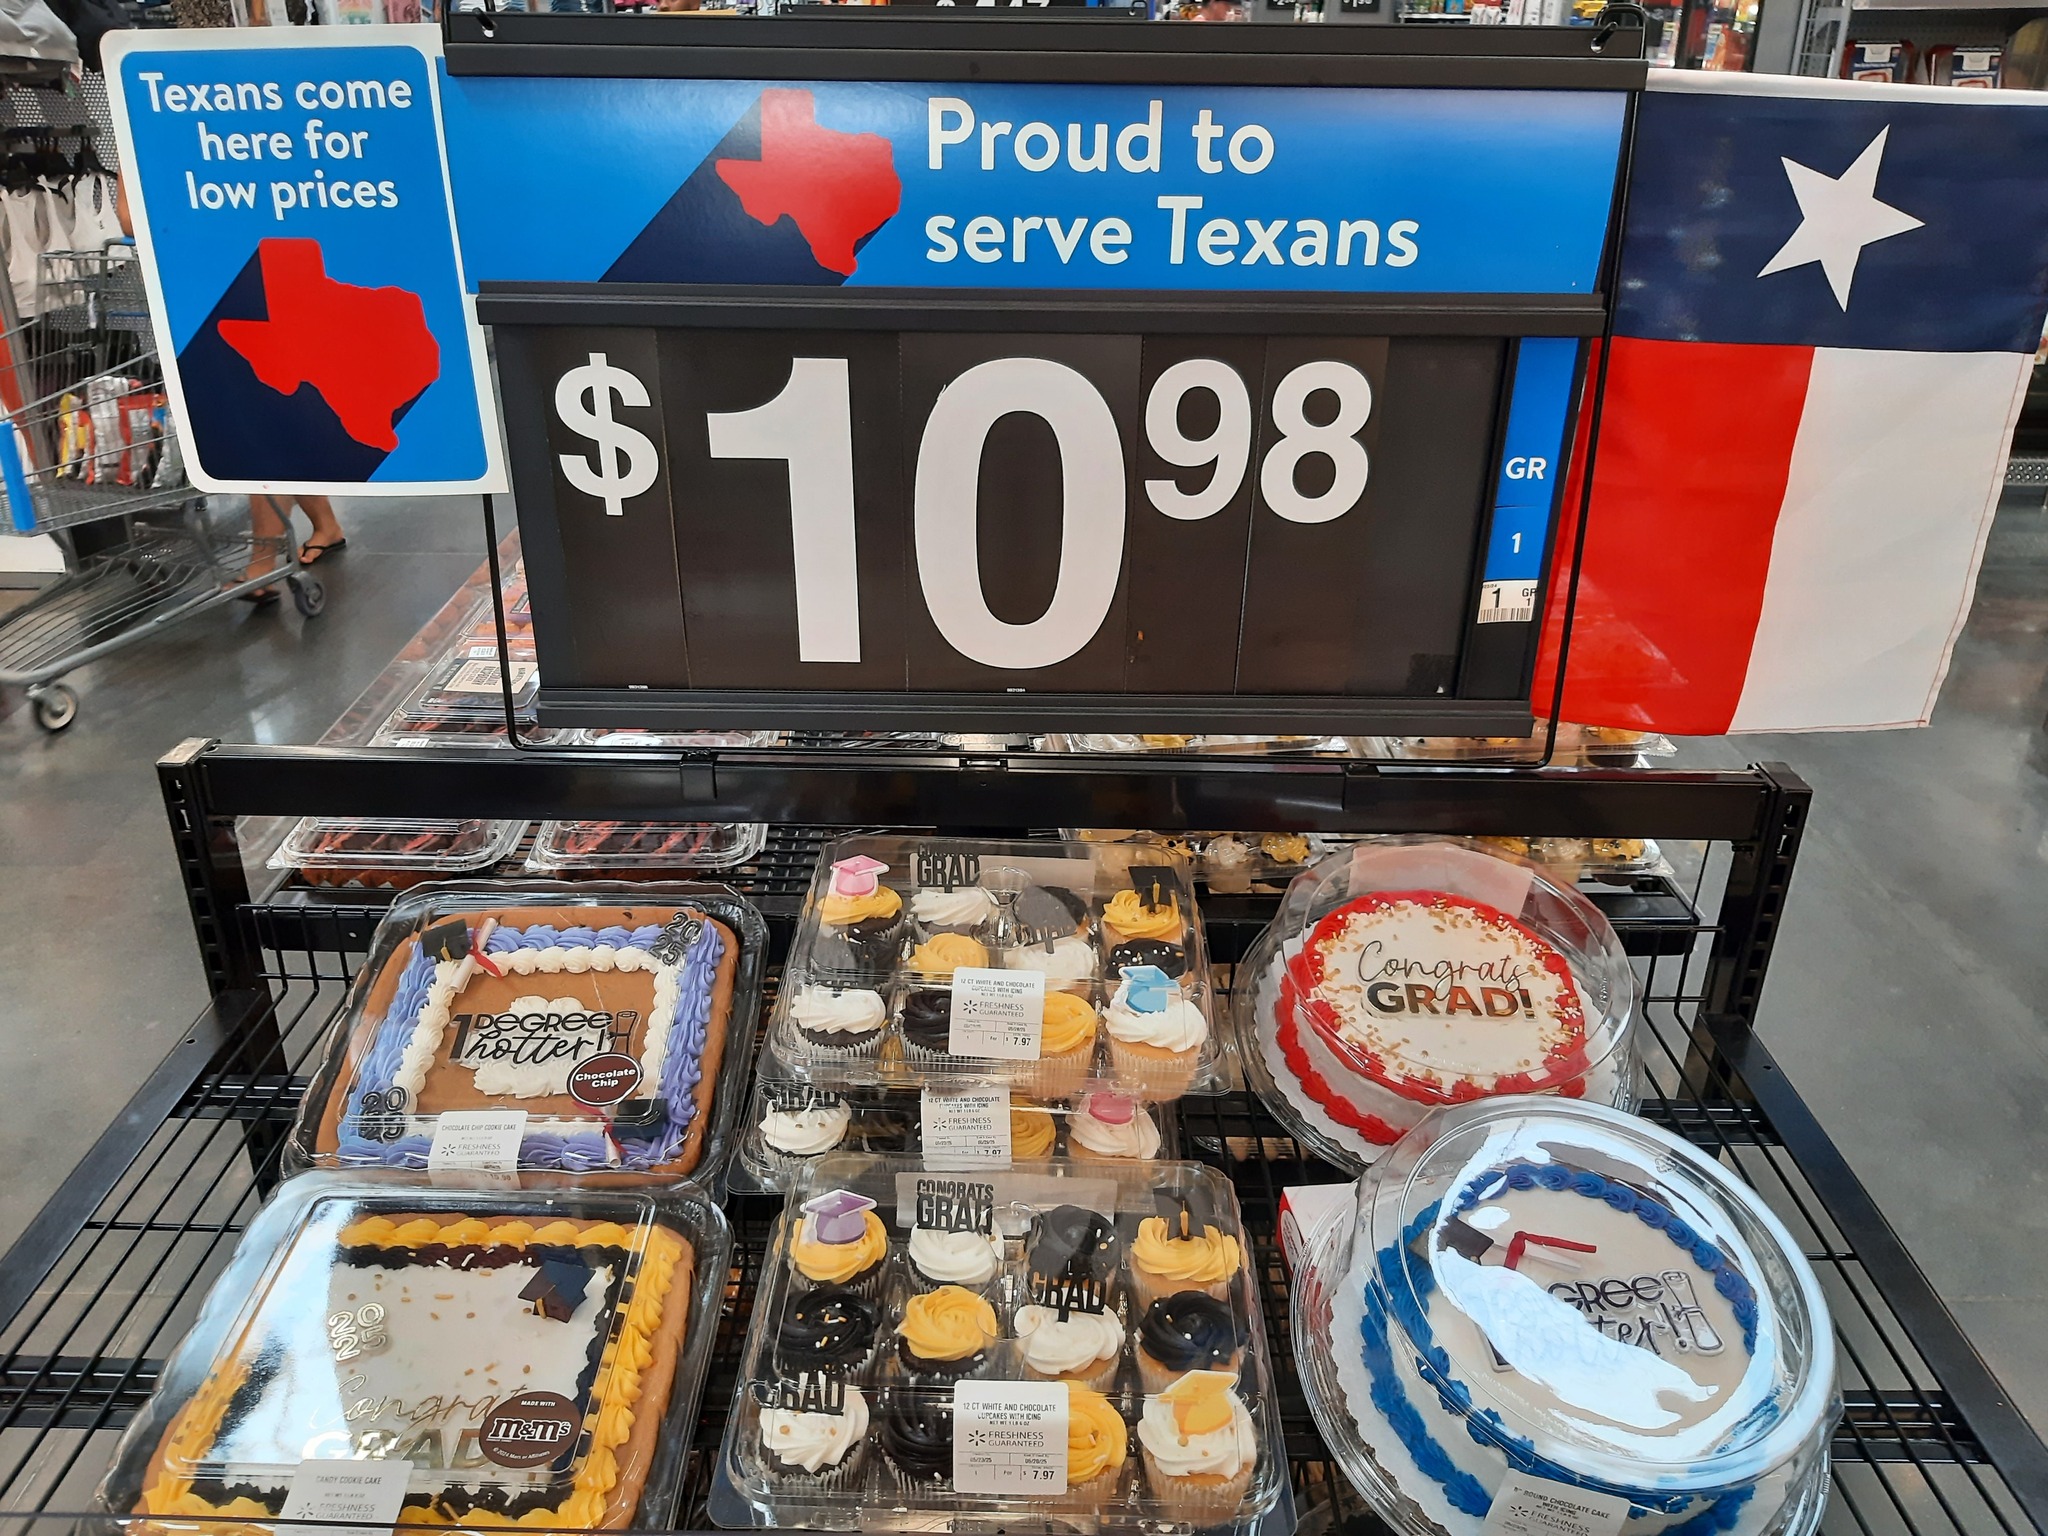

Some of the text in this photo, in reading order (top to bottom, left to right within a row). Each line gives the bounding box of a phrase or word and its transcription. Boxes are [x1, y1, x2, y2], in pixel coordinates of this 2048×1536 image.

[139, 73, 412, 112] Texans come
[197, 119, 369, 161] here for
[927, 96, 1275, 175] Proud to
[185, 169, 398, 221] low prices
[925, 195, 1420, 267] serve Texans
[1505, 457, 1547, 480] GR
[1511, 532, 1522, 554] 1
[1492, 587, 1501, 609] 1
[917, 855, 981, 888] GRAD
[1358, 940, 1530, 1001] Congrats
[1005, 981, 1035, 989] CHOCOLATE
[979, 1001, 1024, 1011] FRESHNESS
[1366, 981, 1537, 1020] GRAD!
[979, 1009, 1024, 1018] GUARANTEED
[449, 1014, 473, 1059] 1
[1013, 1036, 1031, 1046] 7.97
[575, 1068, 636, 1082] Chocolate
[591, 1078, 619, 1088] Chip
[916, 1178, 994, 1201] CONGRATS
[916, 1193, 993, 1235] GRAD
[328, 1302, 386, 1338] 20
[332, 1324, 388, 1362] 25
[963, 1402, 1056, 1412] 12 CT WHITE AND CHOCOLATE
[988, 1431, 1044, 1440] FRESHNESS
[988, 1440, 1044, 1448] GUARANTEED
[339, 1476, 362, 1484] COOKIE
[364, 1476, 382, 1485] CAKE
[1032, 1470, 1055, 1480] 7.97
[1523, 1490, 1549, 1501] ROUND
[1549, 1497, 1590, 1514] CHOCOLATE
[1591, 1509, 1610, 1520] CAKE
[1530, 1510, 1590, 1533] FRESHNESS
